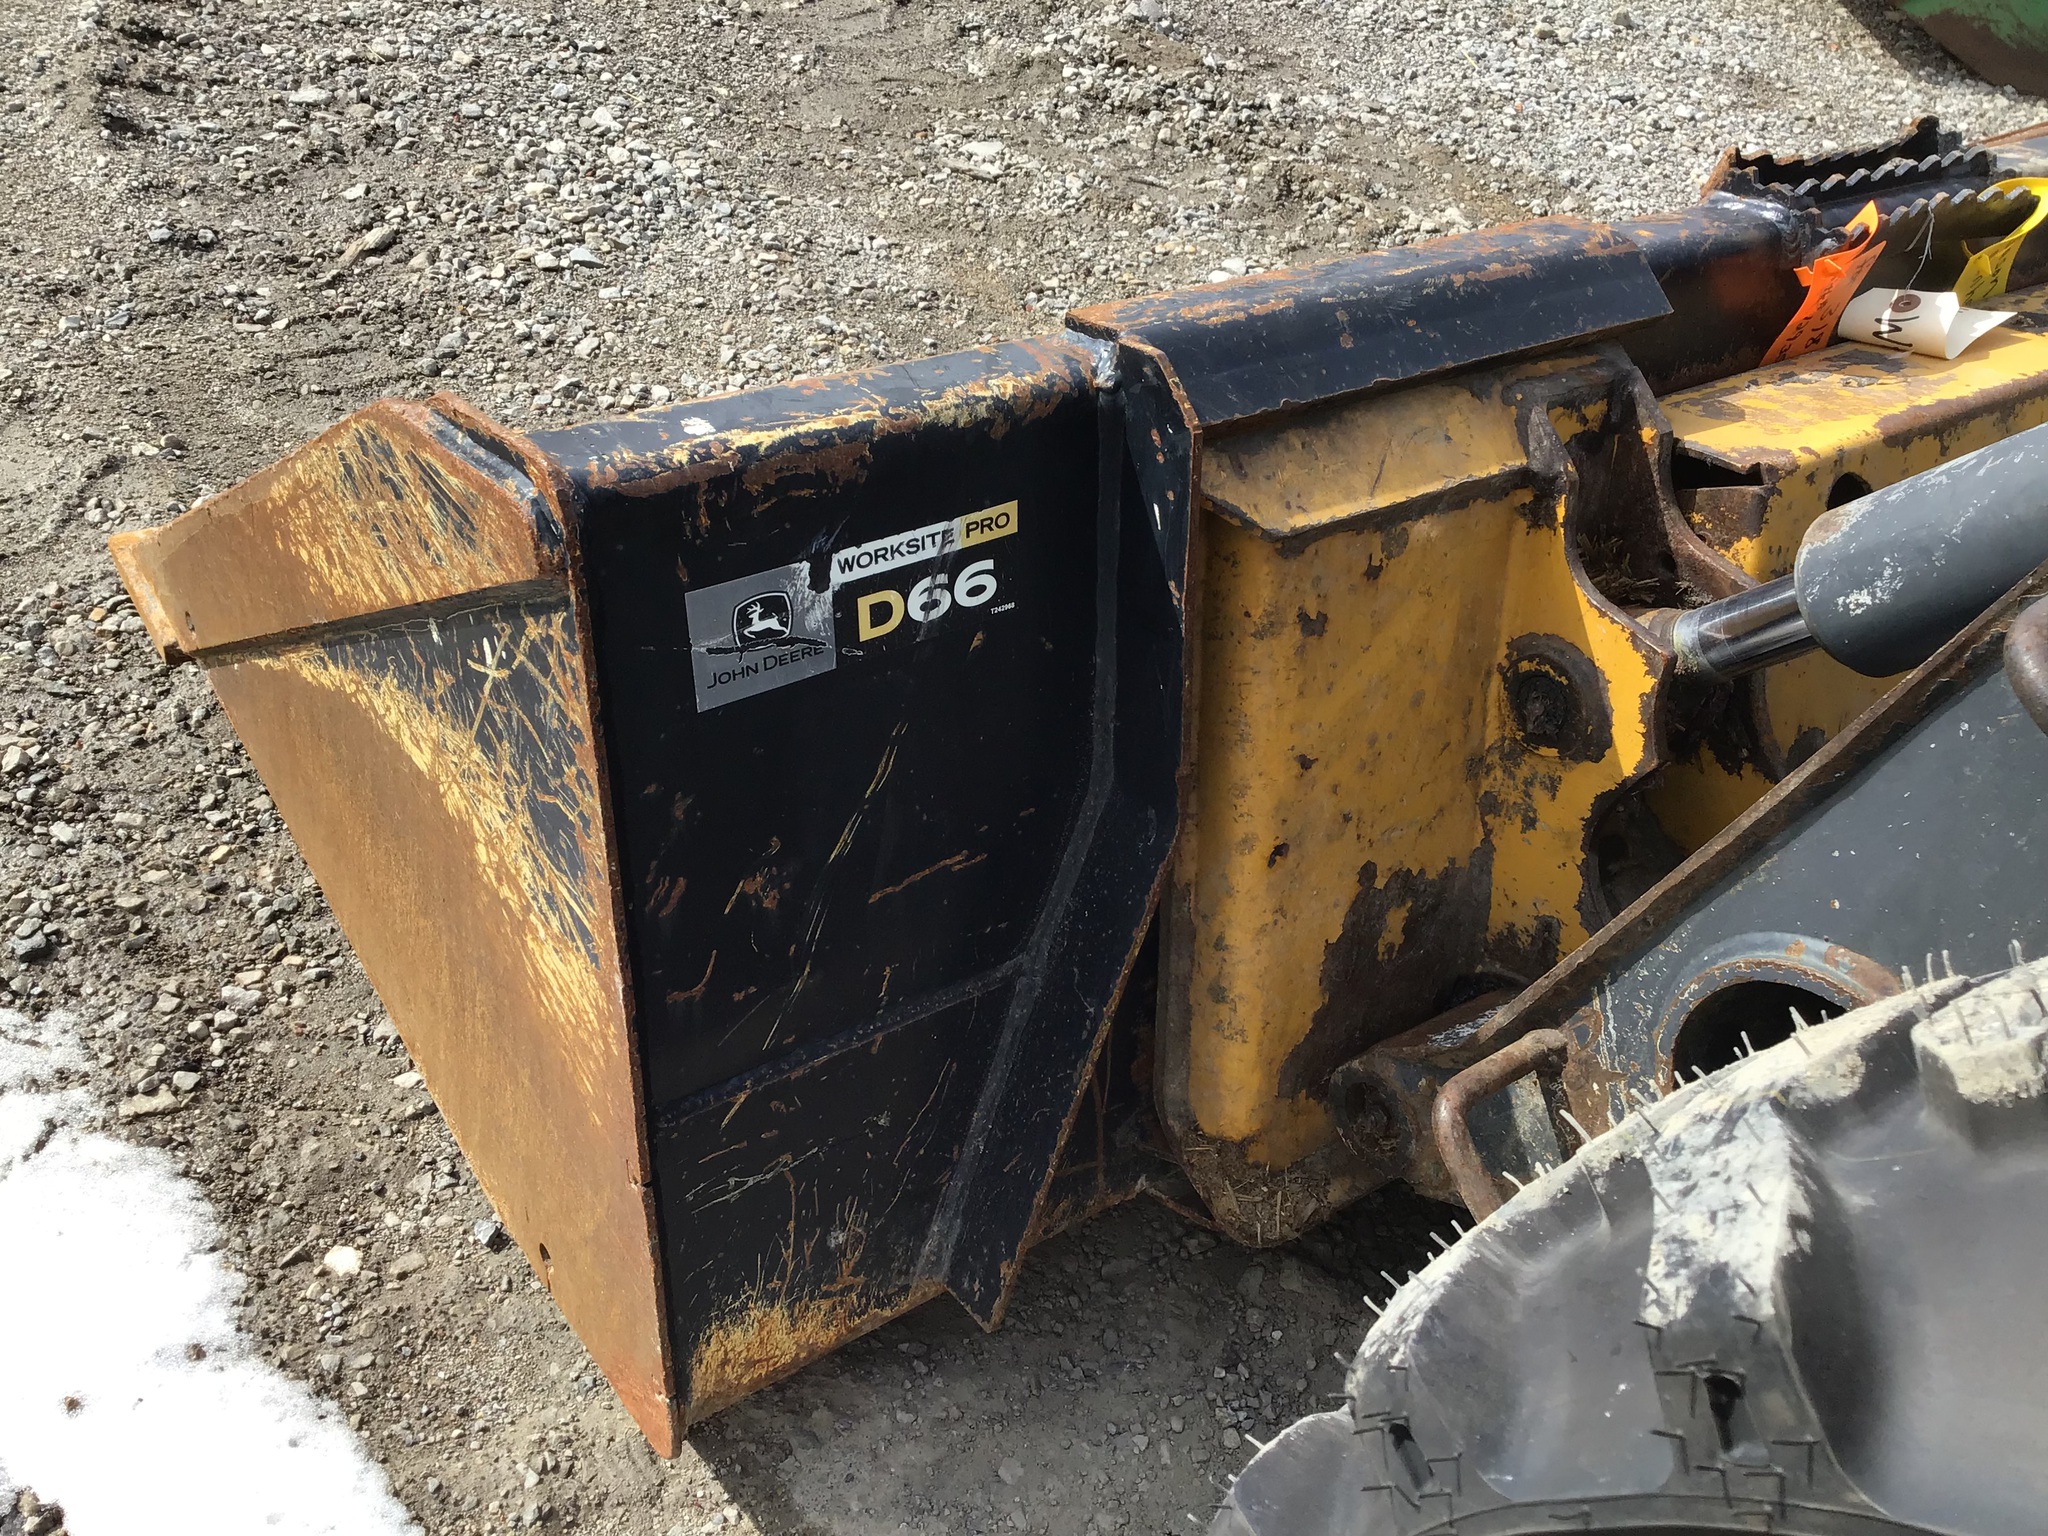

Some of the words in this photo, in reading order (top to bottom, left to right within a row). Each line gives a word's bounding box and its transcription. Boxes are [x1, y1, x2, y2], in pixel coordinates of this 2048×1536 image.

[837, 528, 955, 574] WORKSITE
[965, 511, 1011, 539] PRO
[857, 558, 998, 643] D66
[706, 662, 759, 689] JOHN
[763, 646, 825, 672] DEERE
